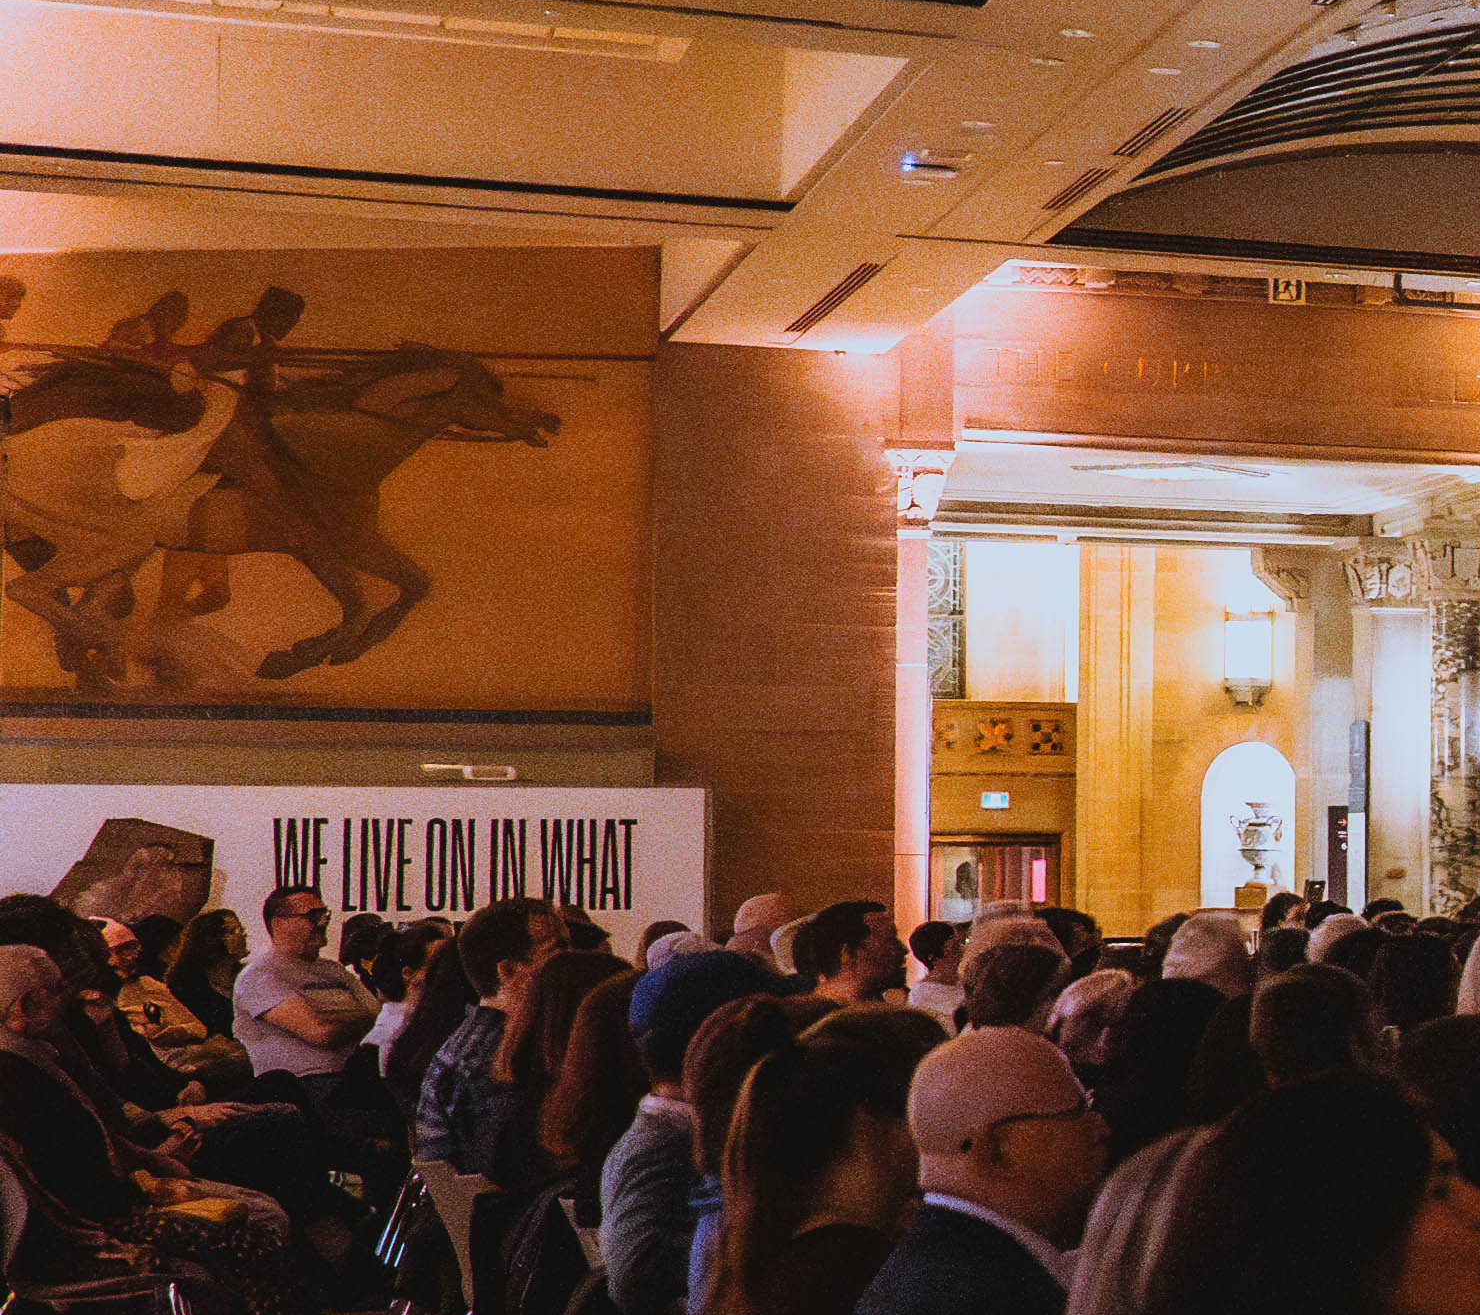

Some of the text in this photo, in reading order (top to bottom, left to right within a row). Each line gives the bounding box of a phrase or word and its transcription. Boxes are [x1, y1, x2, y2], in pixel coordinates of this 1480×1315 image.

[341, 817, 414, 912] LIVE
[425, 817, 476, 912] ON
[490, 818, 527, 902] IN
[540, 818, 638, 911] WHAT
